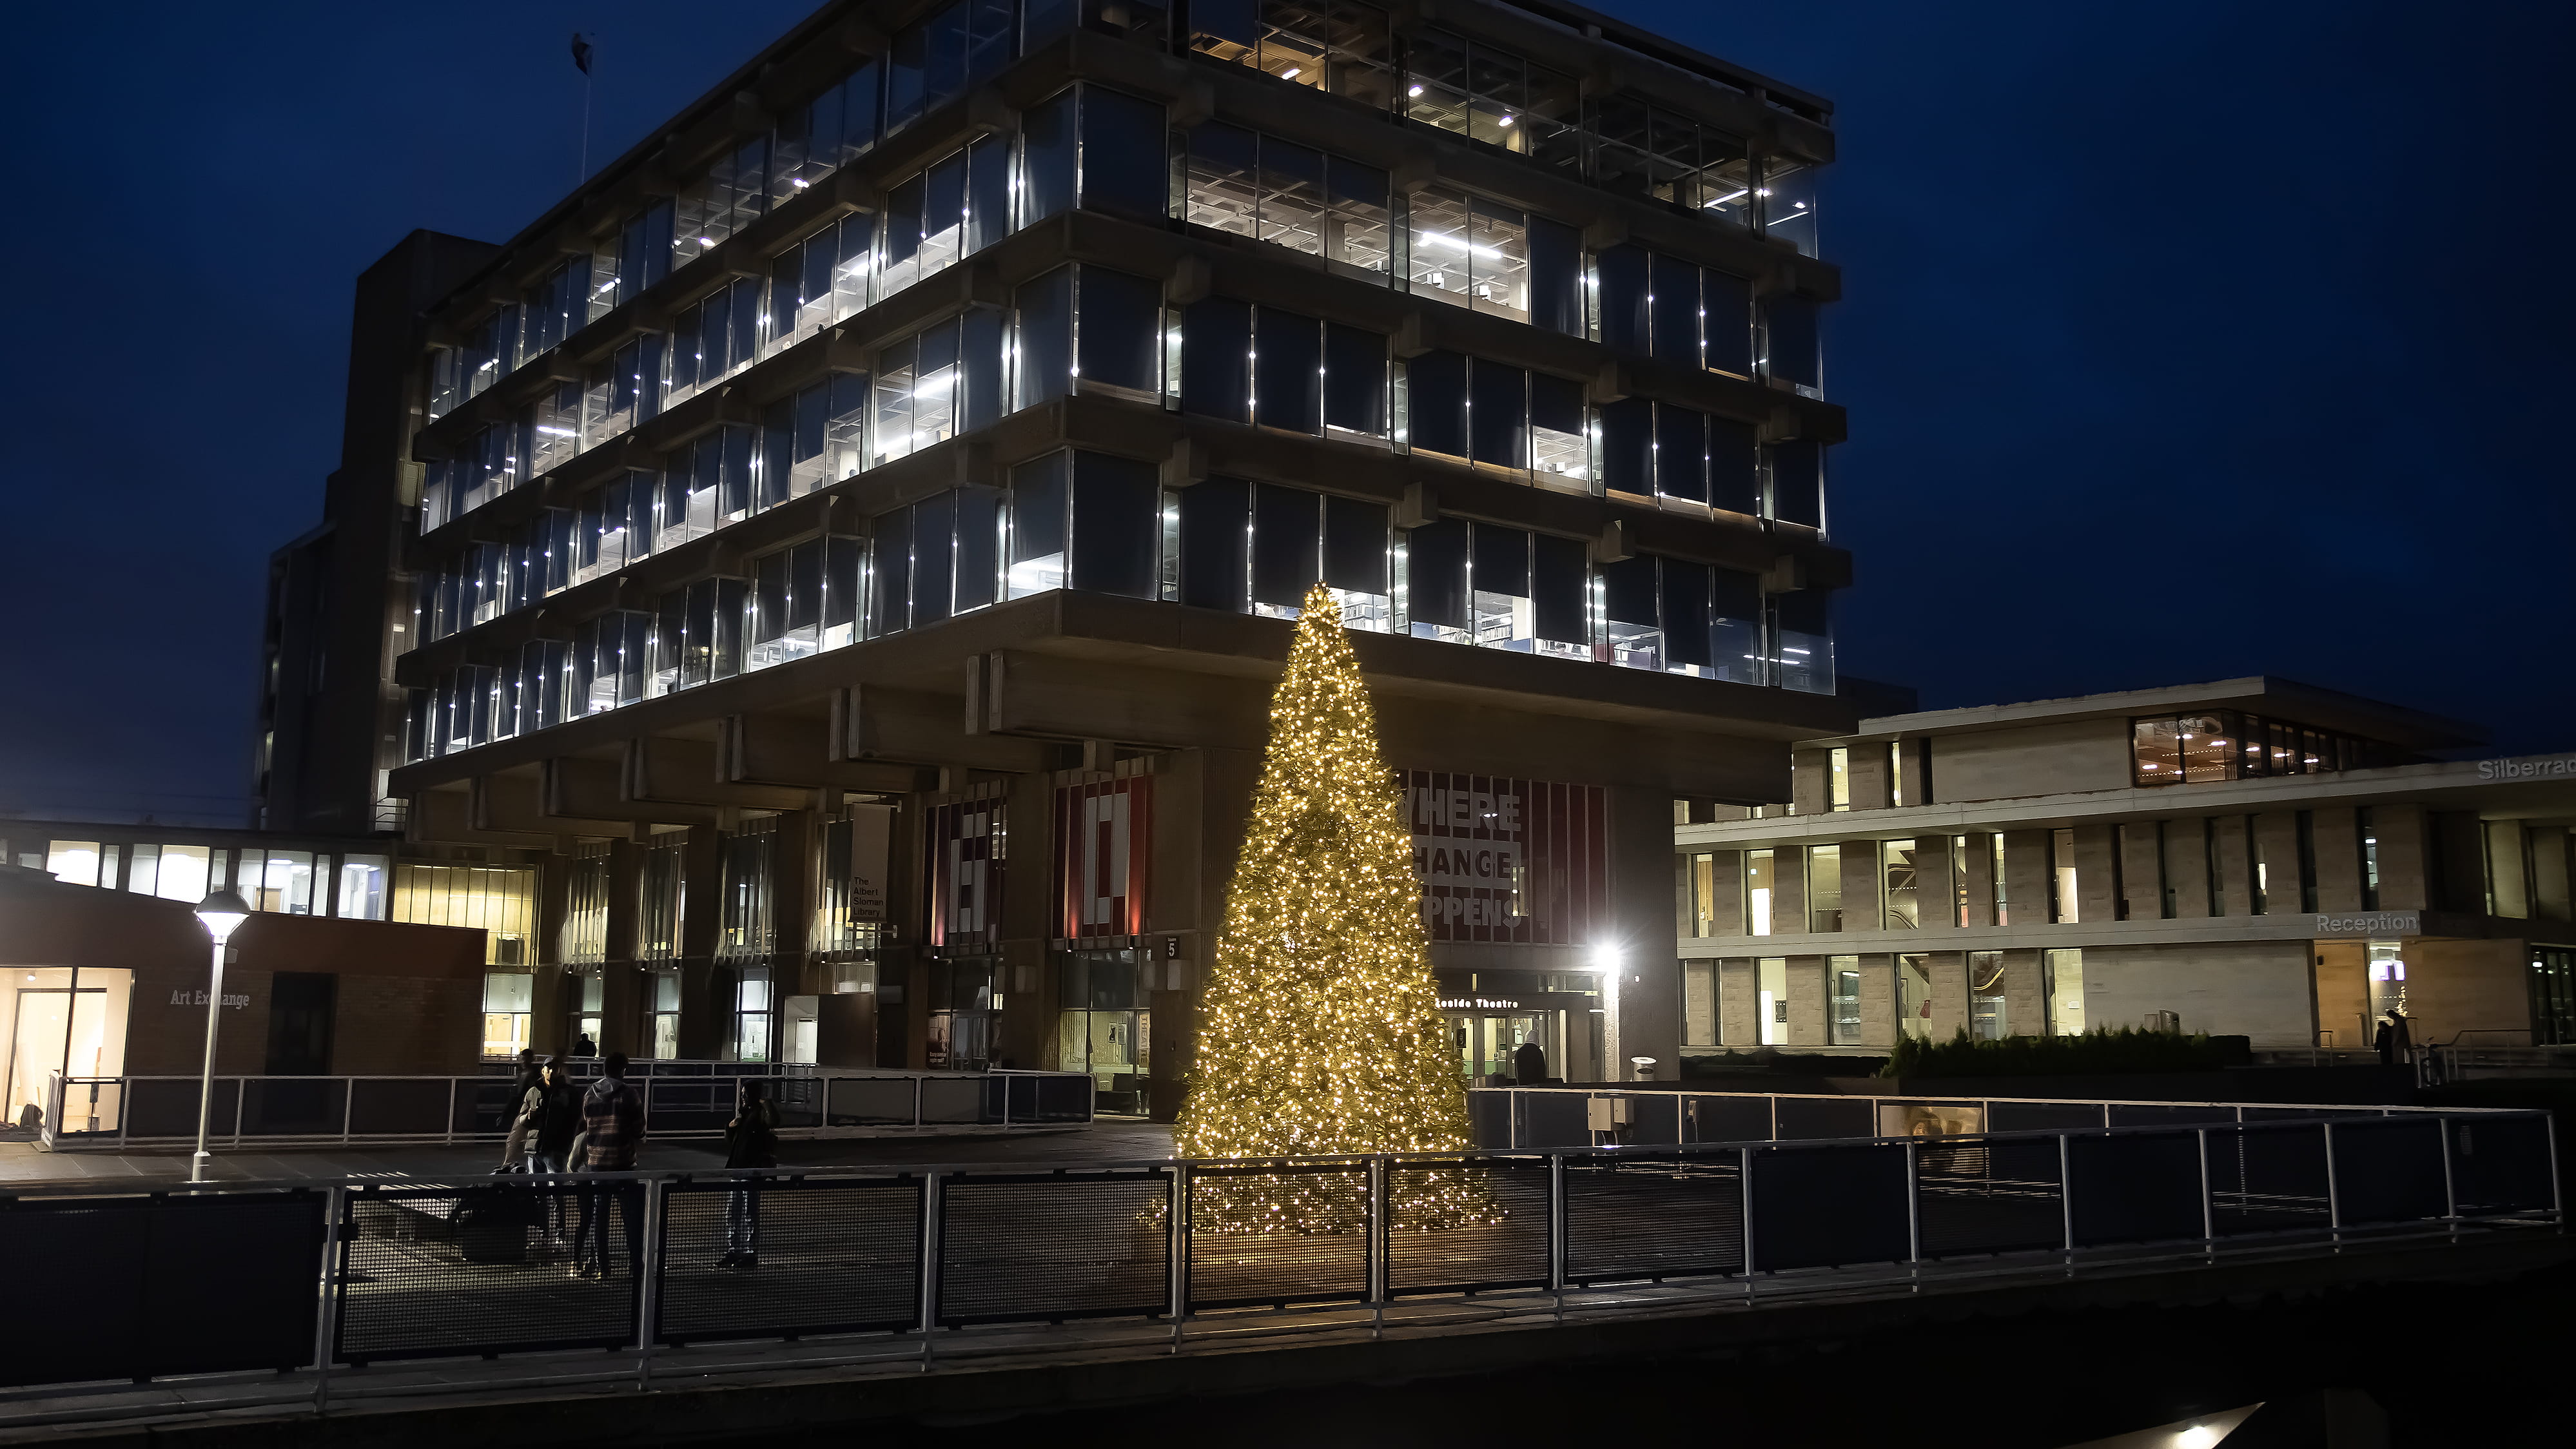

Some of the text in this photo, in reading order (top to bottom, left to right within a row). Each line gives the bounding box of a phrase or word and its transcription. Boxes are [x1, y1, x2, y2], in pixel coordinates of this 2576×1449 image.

[1414, 846, 1510, 879] HANGE
[854, 877, 869, 885] The
[854, 887, 878, 895] Albert
[853, 897, 884, 906] Sloman
[853, 907, 881, 917] Library
[2316, 913, 2417, 935] Reception
[1169, 943, 1175, 957] 5
[170, 989, 250, 1010] Art Exange
[1476, 998, 1519, 1009] Theatre
